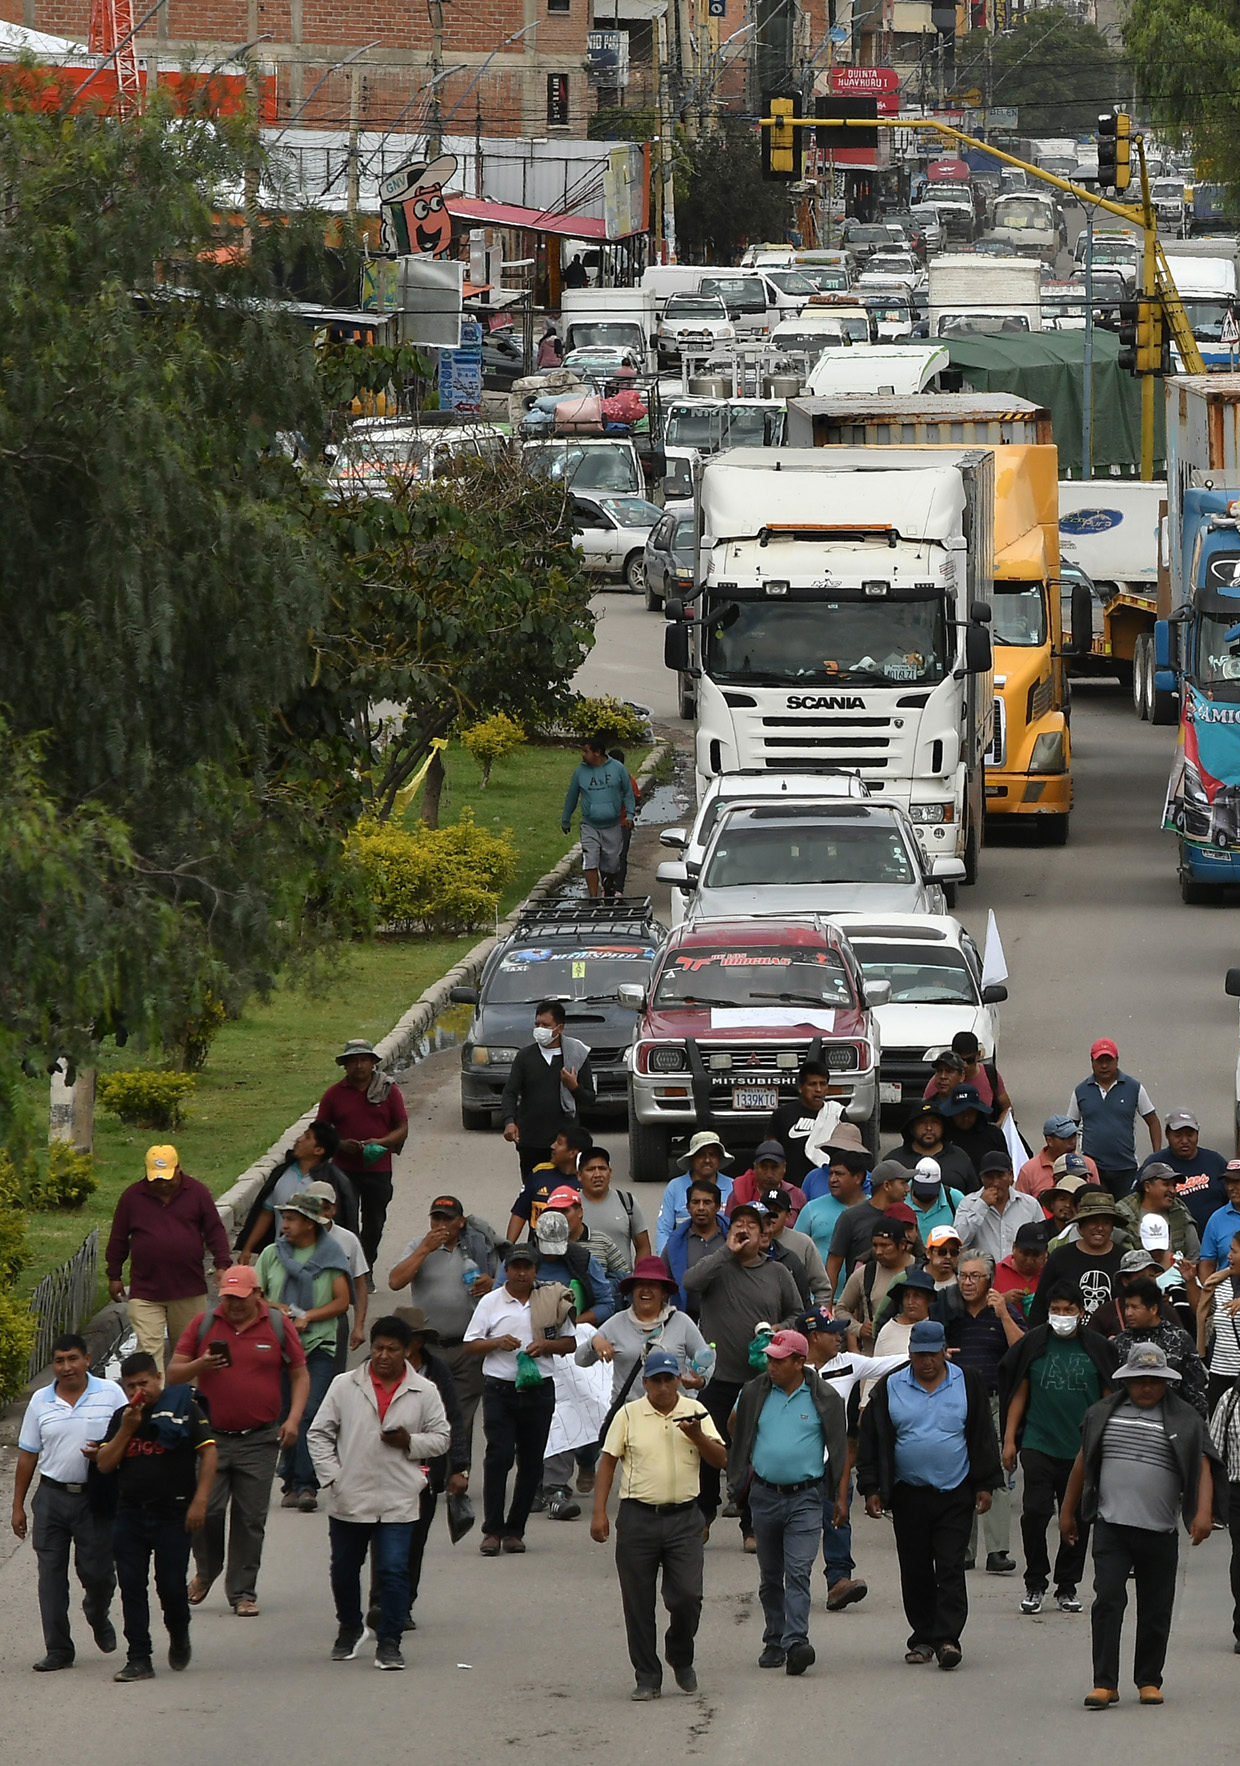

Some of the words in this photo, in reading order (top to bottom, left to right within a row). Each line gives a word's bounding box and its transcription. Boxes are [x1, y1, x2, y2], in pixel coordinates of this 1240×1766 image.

[848, 70, 877, 78] QUINTA
[386, 175, 405, 193] GNV
[786, 696, 866, 709] SCANIA
